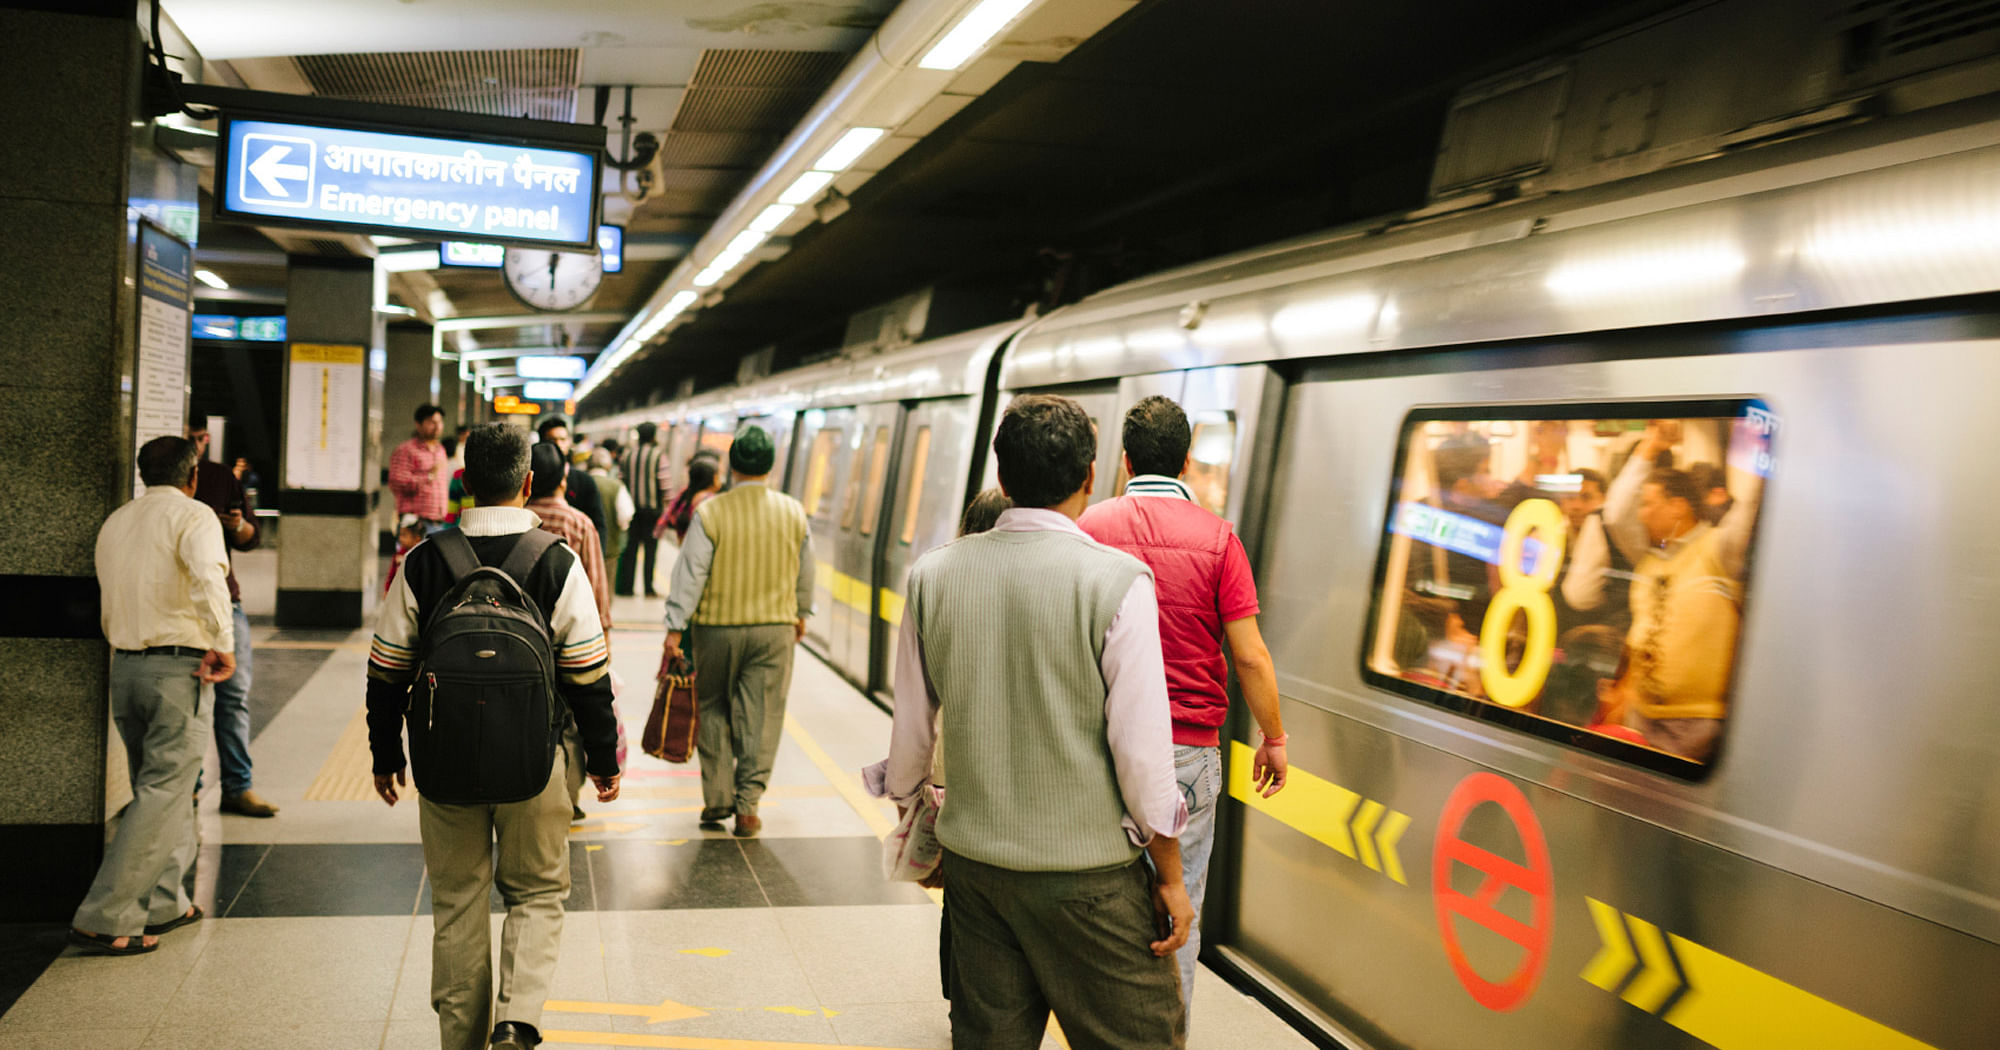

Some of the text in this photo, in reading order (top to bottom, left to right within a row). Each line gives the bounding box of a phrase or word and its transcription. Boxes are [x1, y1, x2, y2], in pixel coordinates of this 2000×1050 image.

[324, 144, 581, 194] आपातकालीन पैनल
[320, 184, 559, 230] Emergency panel
[1479, 498, 1567, 708] 8
